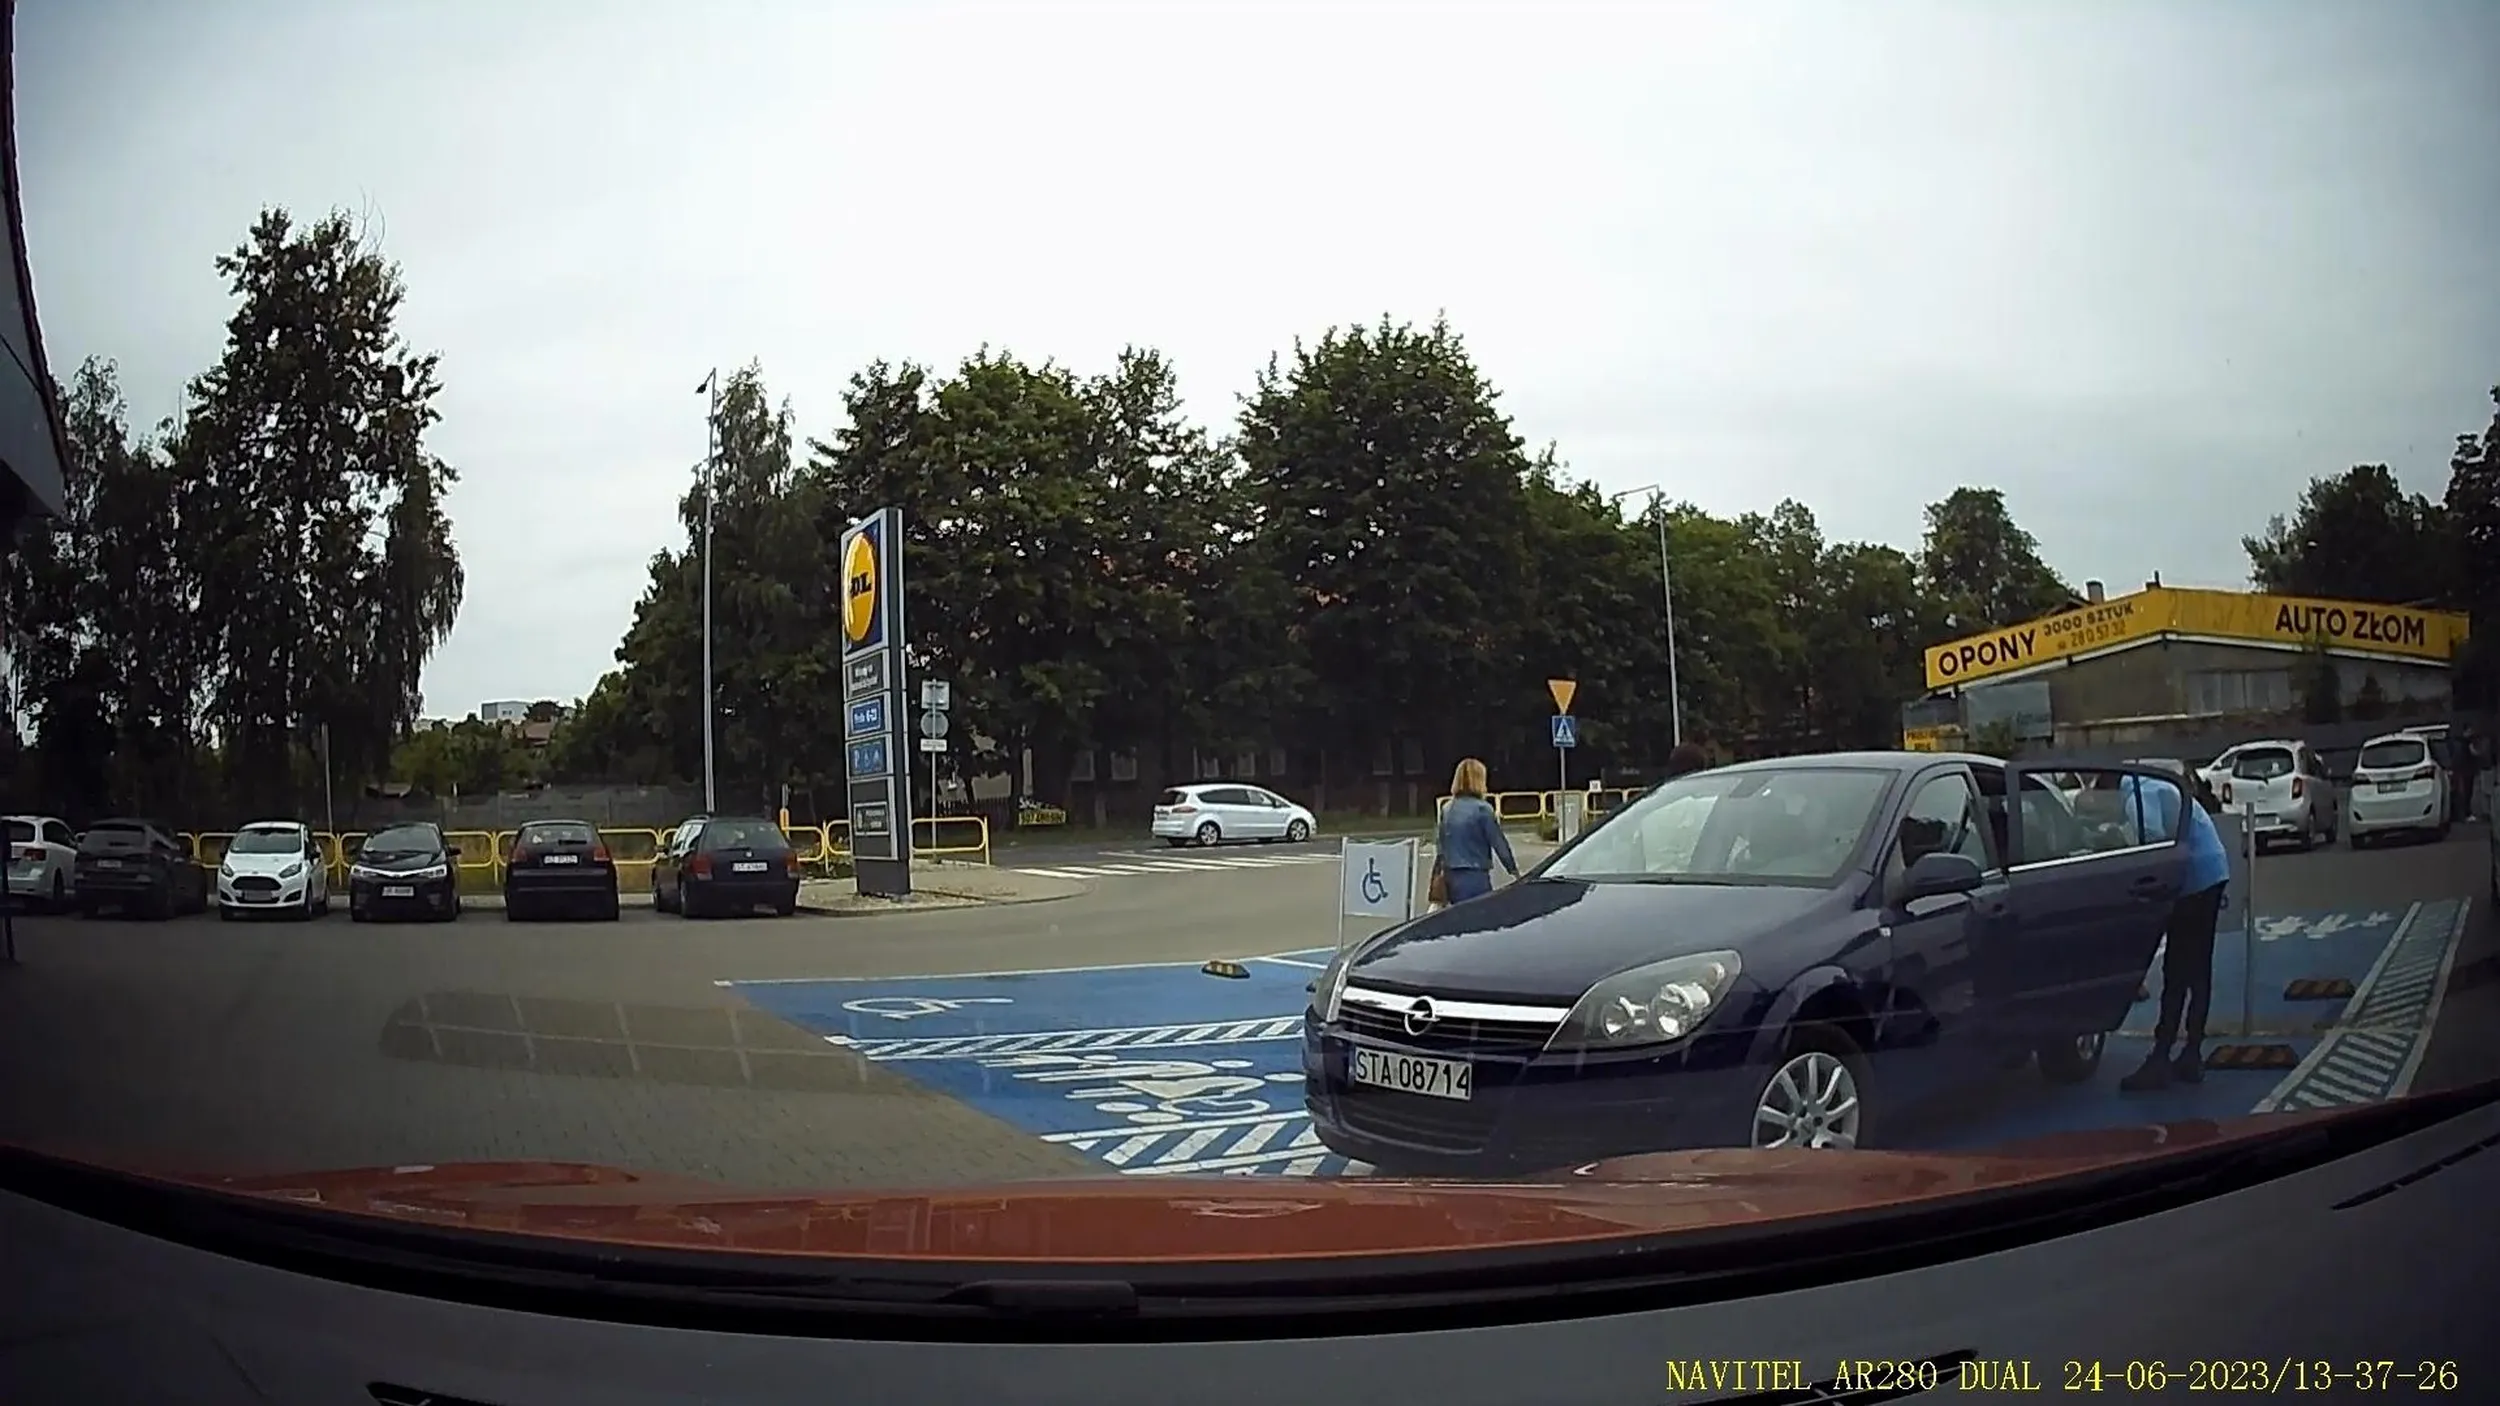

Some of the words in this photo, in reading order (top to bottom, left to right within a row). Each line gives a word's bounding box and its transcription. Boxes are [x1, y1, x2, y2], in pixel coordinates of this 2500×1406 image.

[2087, 602, 2135, 625] SZTUK
[2275, 604, 2347, 636] AUTO
[2352, 610, 2426, 646] ZŁOM
[1938, 628, 2036, 677] OPONY
[1356, 1051, 1392, 1085] STA
[1399, 1057, 1471, 1097] 08714
